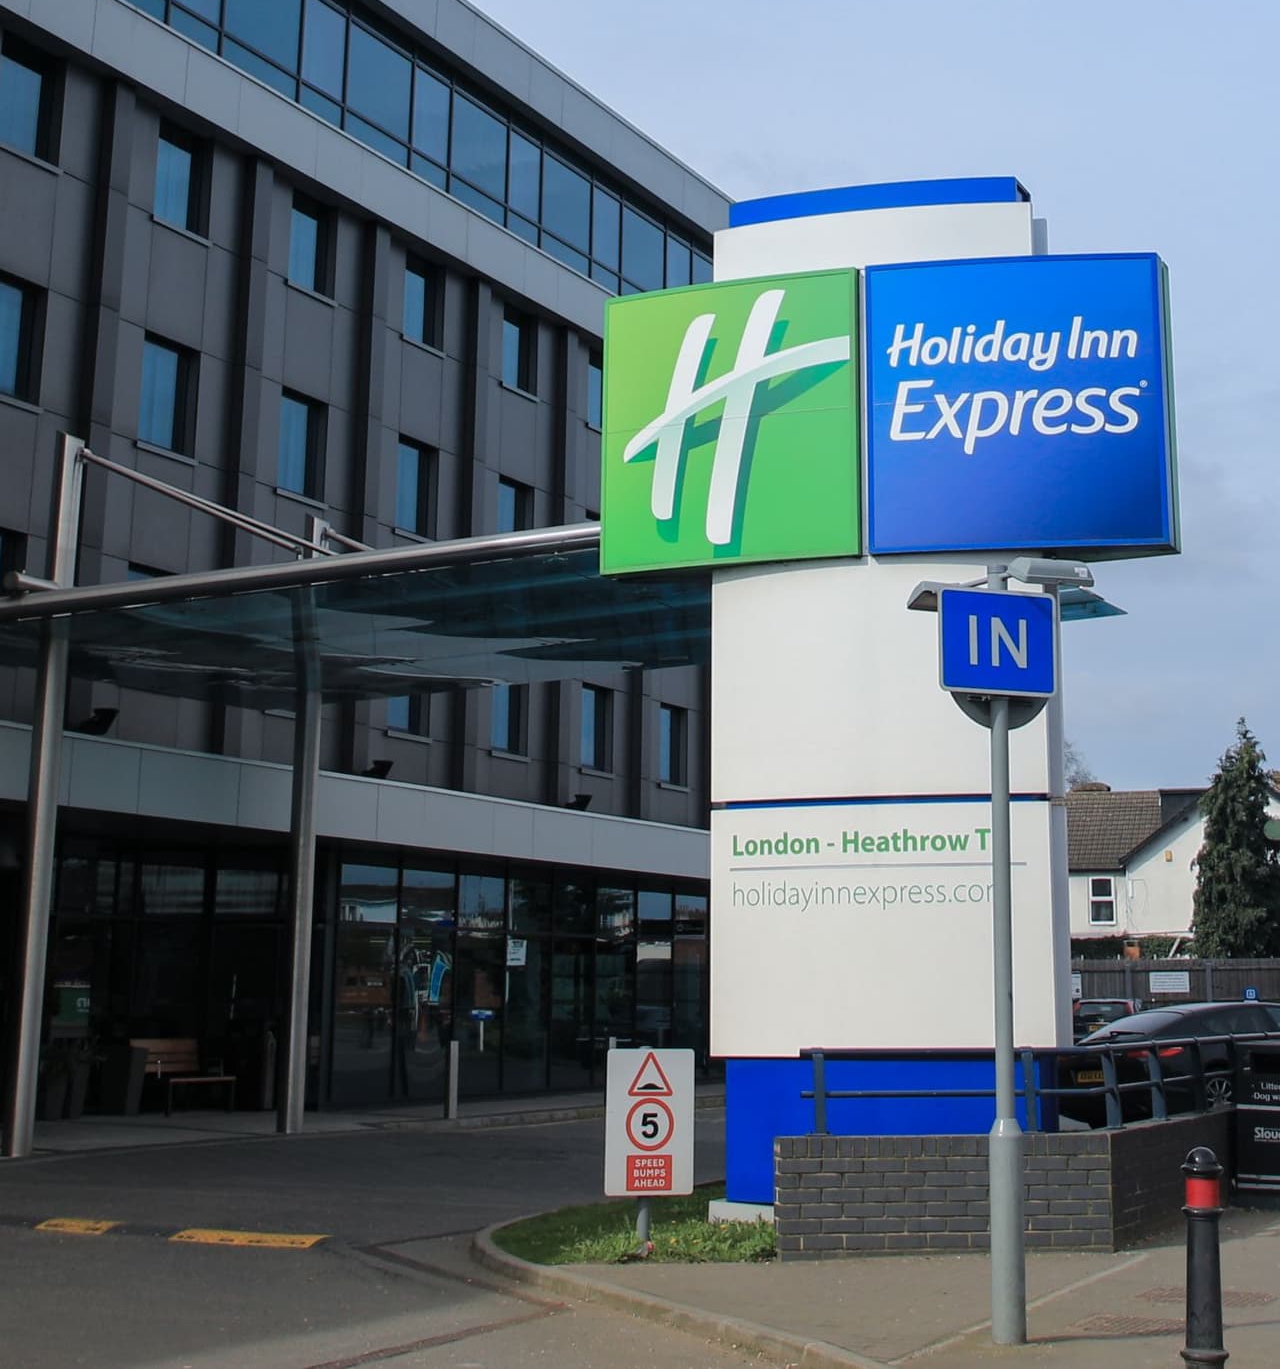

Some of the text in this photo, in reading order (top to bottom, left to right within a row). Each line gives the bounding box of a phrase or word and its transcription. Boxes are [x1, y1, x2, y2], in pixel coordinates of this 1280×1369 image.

[886, 316, 1138, 372] Holiday Inn
[889, 379, 1141, 455] Express
[968, 614, 1029, 669] IN
[732, 832, 820, 856] London
[842, 829, 970, 853] Heathrow
[975, 828, 993, 851] T
[1253, 1092, 1271, 1102] Dog
[641, 1112, 660, 1139] 5
[633, 1169, 666, 1177] BUMPS
[635, 1159, 665, 1167] SPEED
[634, 1179, 666, 1187] AHEAD
